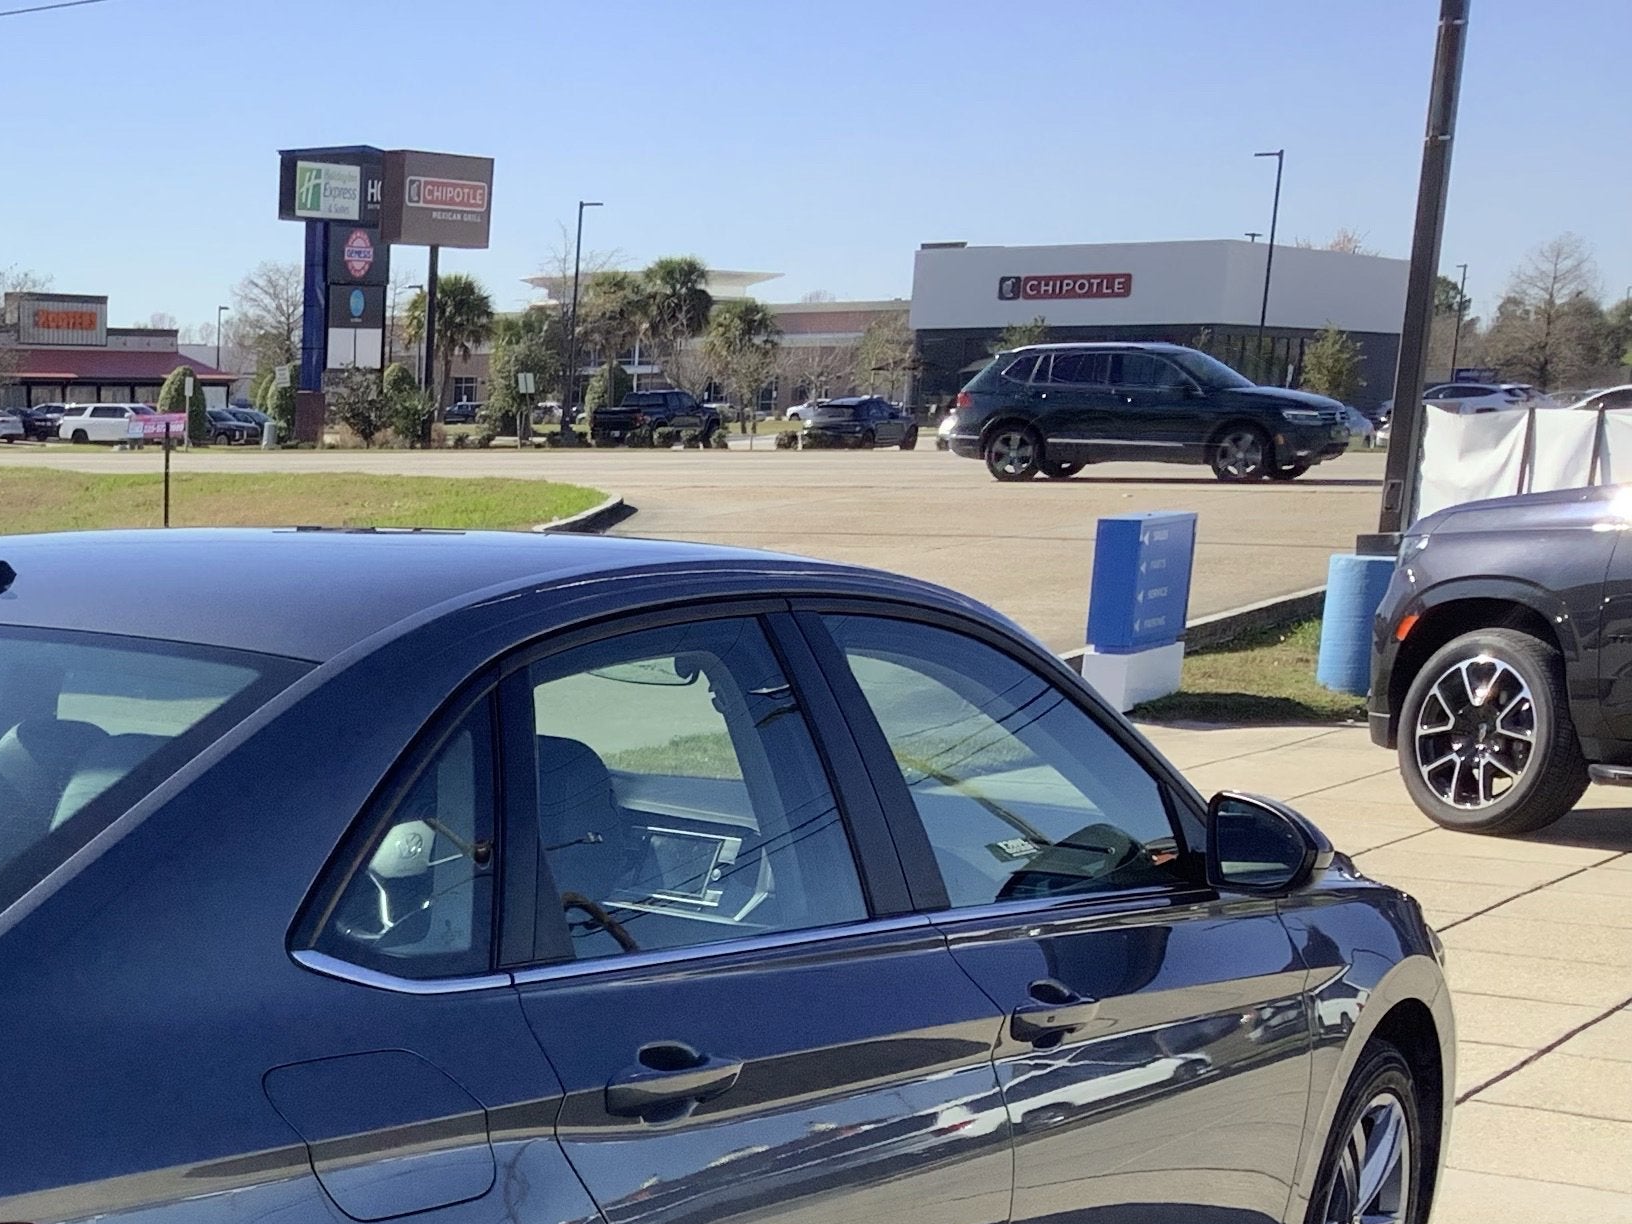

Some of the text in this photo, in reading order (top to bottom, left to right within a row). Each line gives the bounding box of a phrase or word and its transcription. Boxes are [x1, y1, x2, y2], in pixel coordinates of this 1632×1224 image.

[323, 182, 358, 201] Express
[424, 184, 484, 205] CHIPOTLE
[432, 211, 481, 222] MEXICAN GRILL
[1025, 278, 1127, 296] CHIPOTLE
